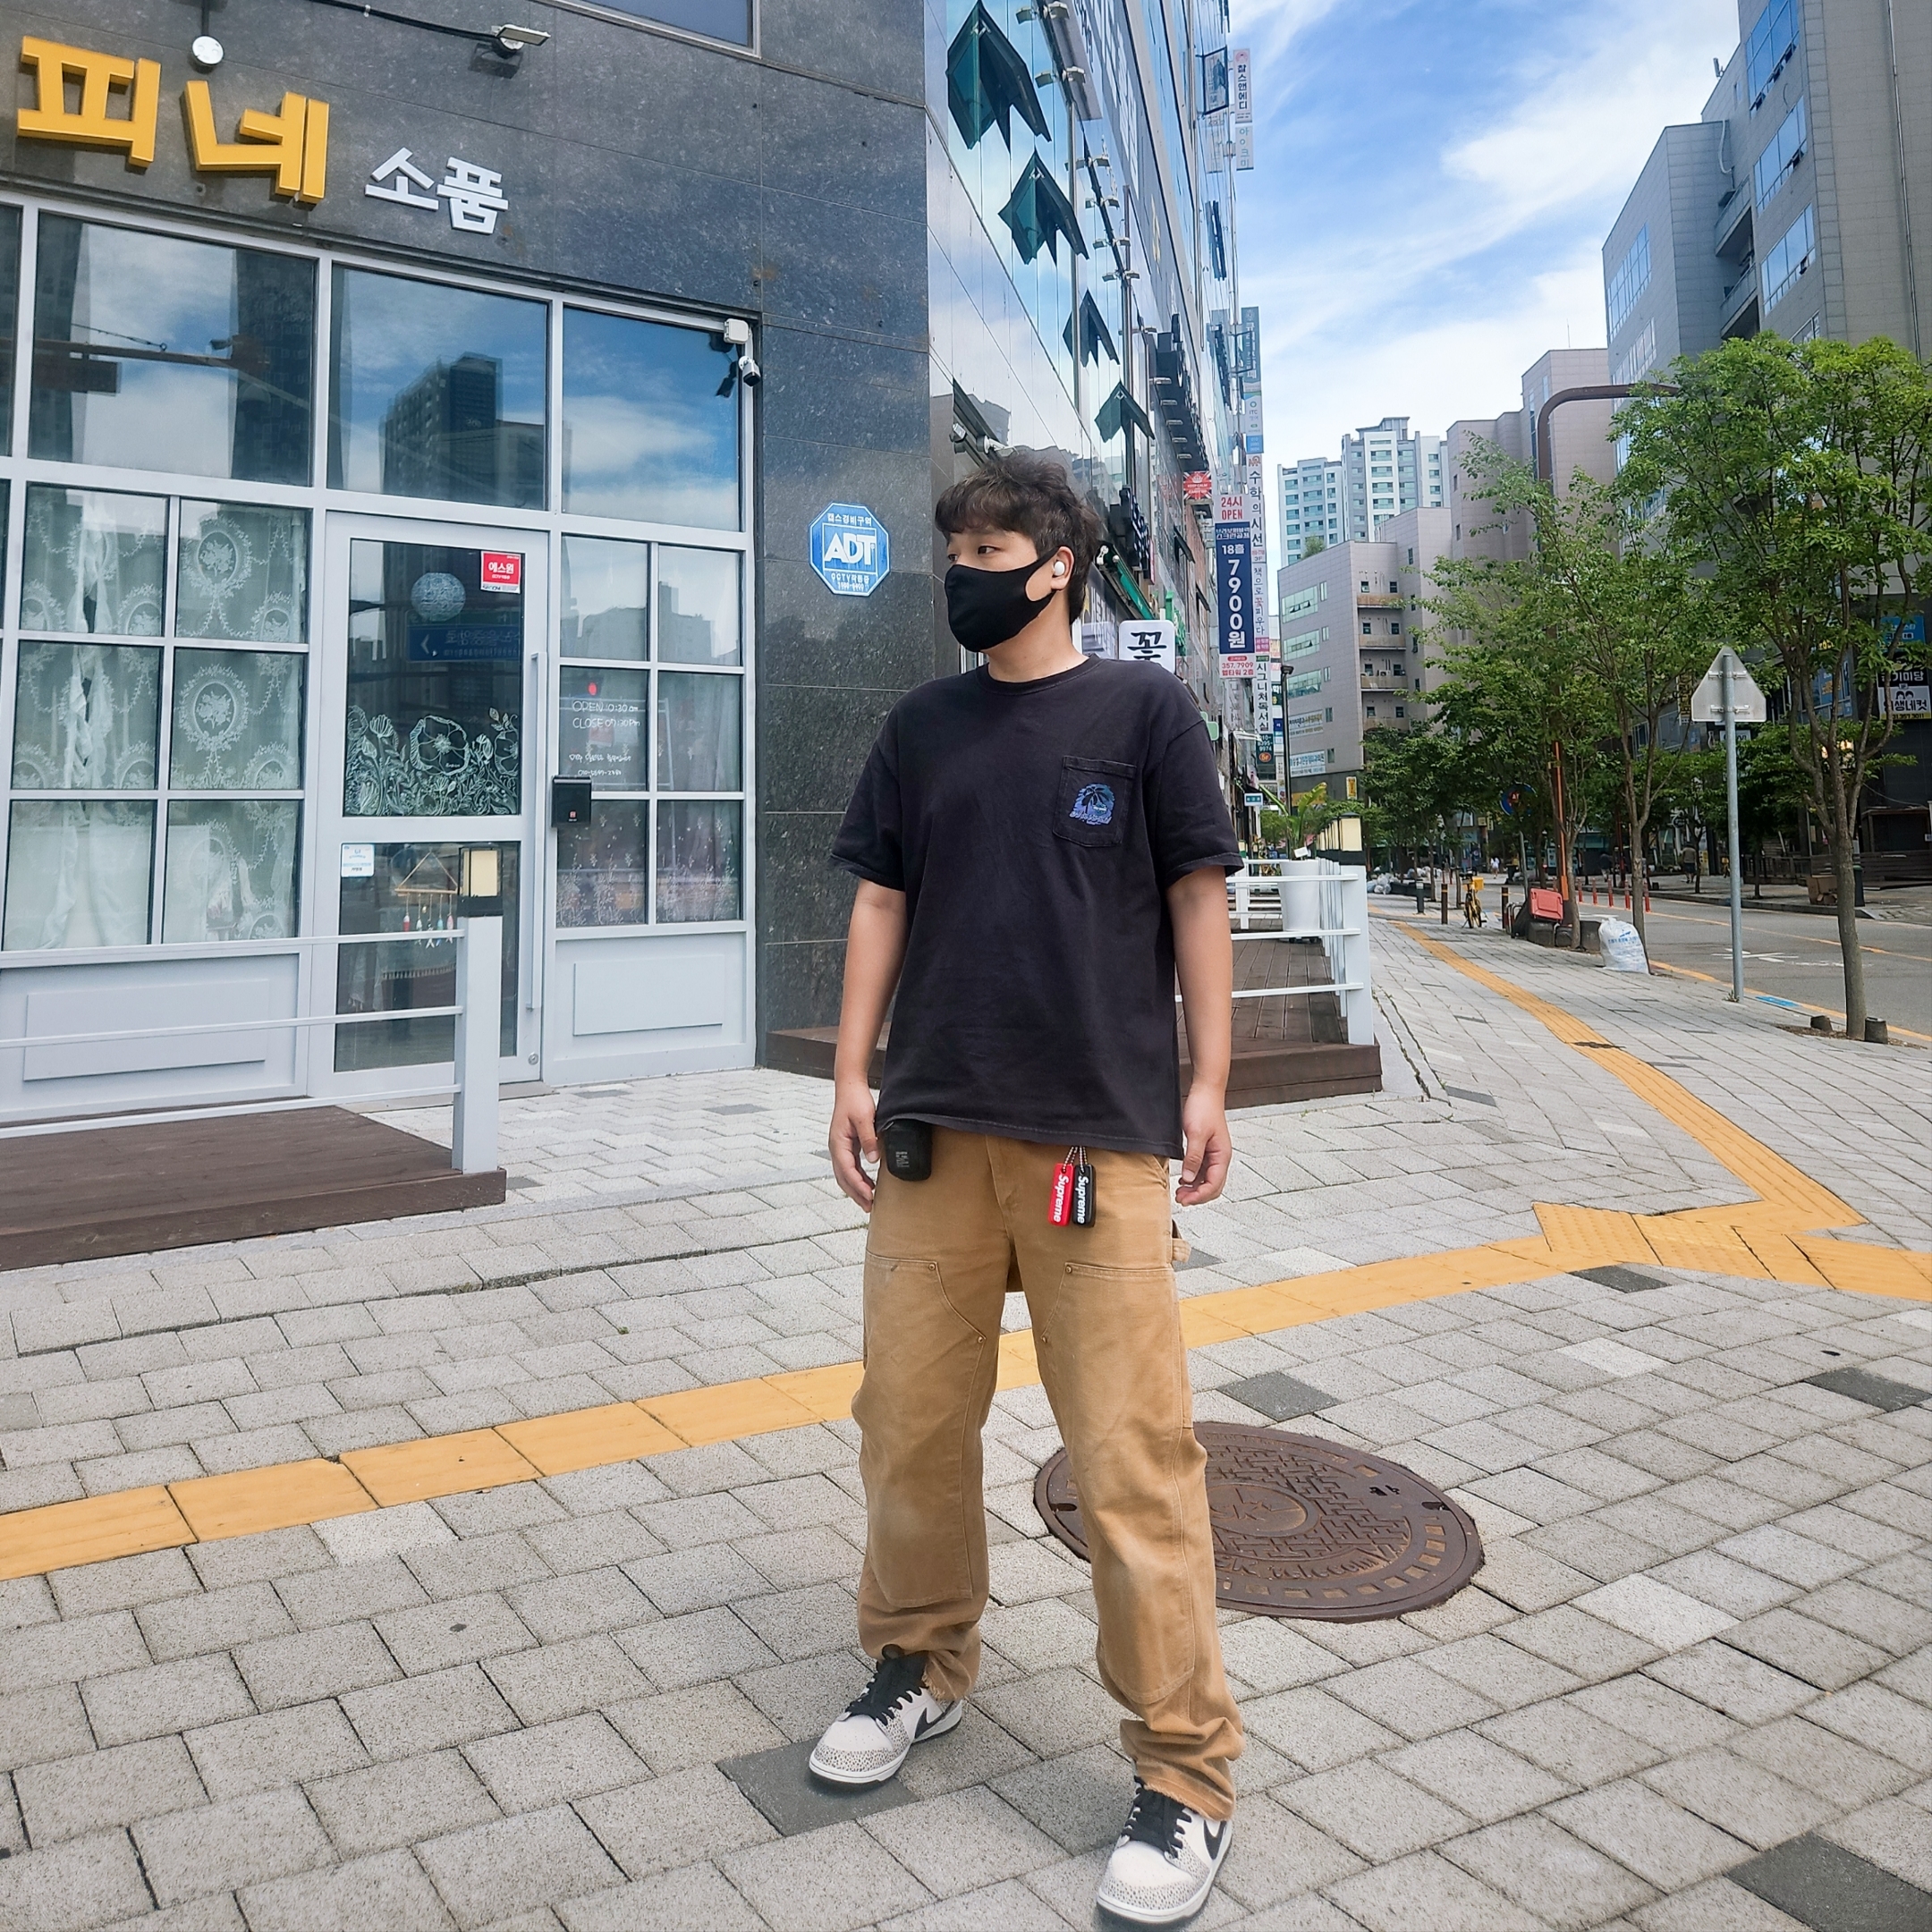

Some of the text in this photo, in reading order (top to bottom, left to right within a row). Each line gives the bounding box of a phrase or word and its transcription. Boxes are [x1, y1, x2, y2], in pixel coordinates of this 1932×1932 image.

[364, 147, 509, 234] 소품
[1221, 496, 1242, 507] 24시
[1222, 509, 1242, 520] OPEN
[1250, 470, 1263, 547] 수학의시선
[824, 532, 877, 565] ADT
[488, 562, 514, 574] 에스원
[572, 700, 604, 713] OPEN
[1256, 663, 1269, 732] 시그니처독서실
[572, 717, 604, 729] CLOSE
[1053, 1174, 1069, 1223] Supreme
[1075, 1175, 1089, 1224] Supreme
